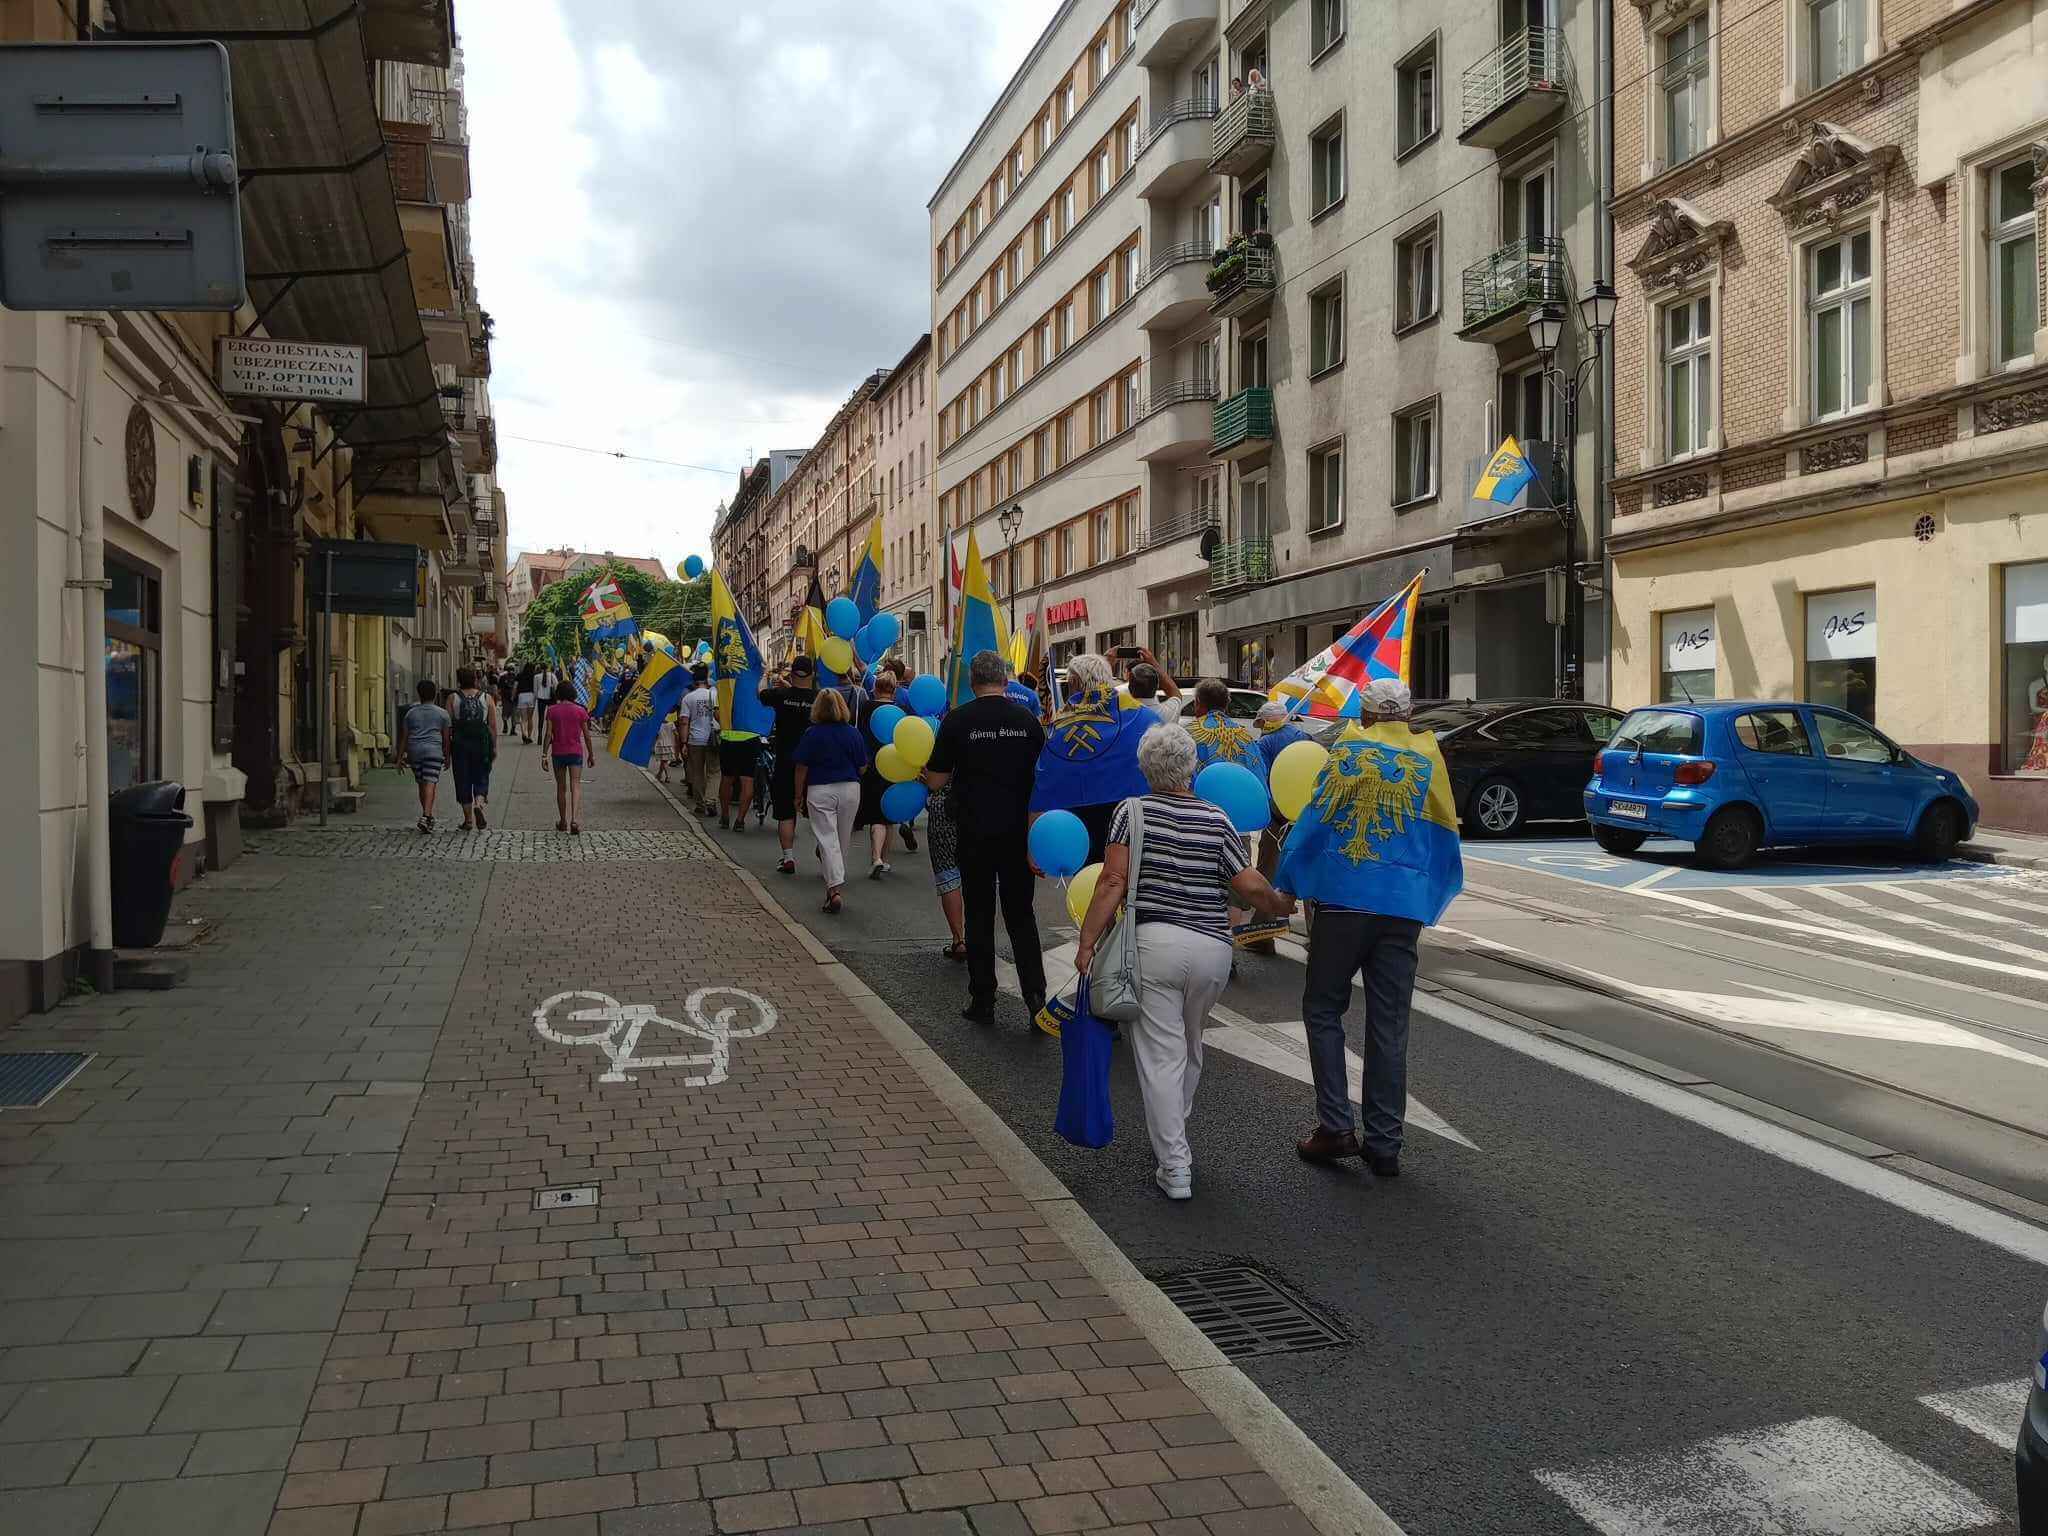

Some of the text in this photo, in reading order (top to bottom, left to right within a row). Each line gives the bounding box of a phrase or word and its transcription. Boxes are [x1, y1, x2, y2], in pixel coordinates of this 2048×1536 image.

[228, 341, 359, 360] ERGO HESTIA S.A.
[233, 355, 354, 374] UBEZPIECZENIA
[232, 369, 353, 387] V.I.P. OPTIMUM
